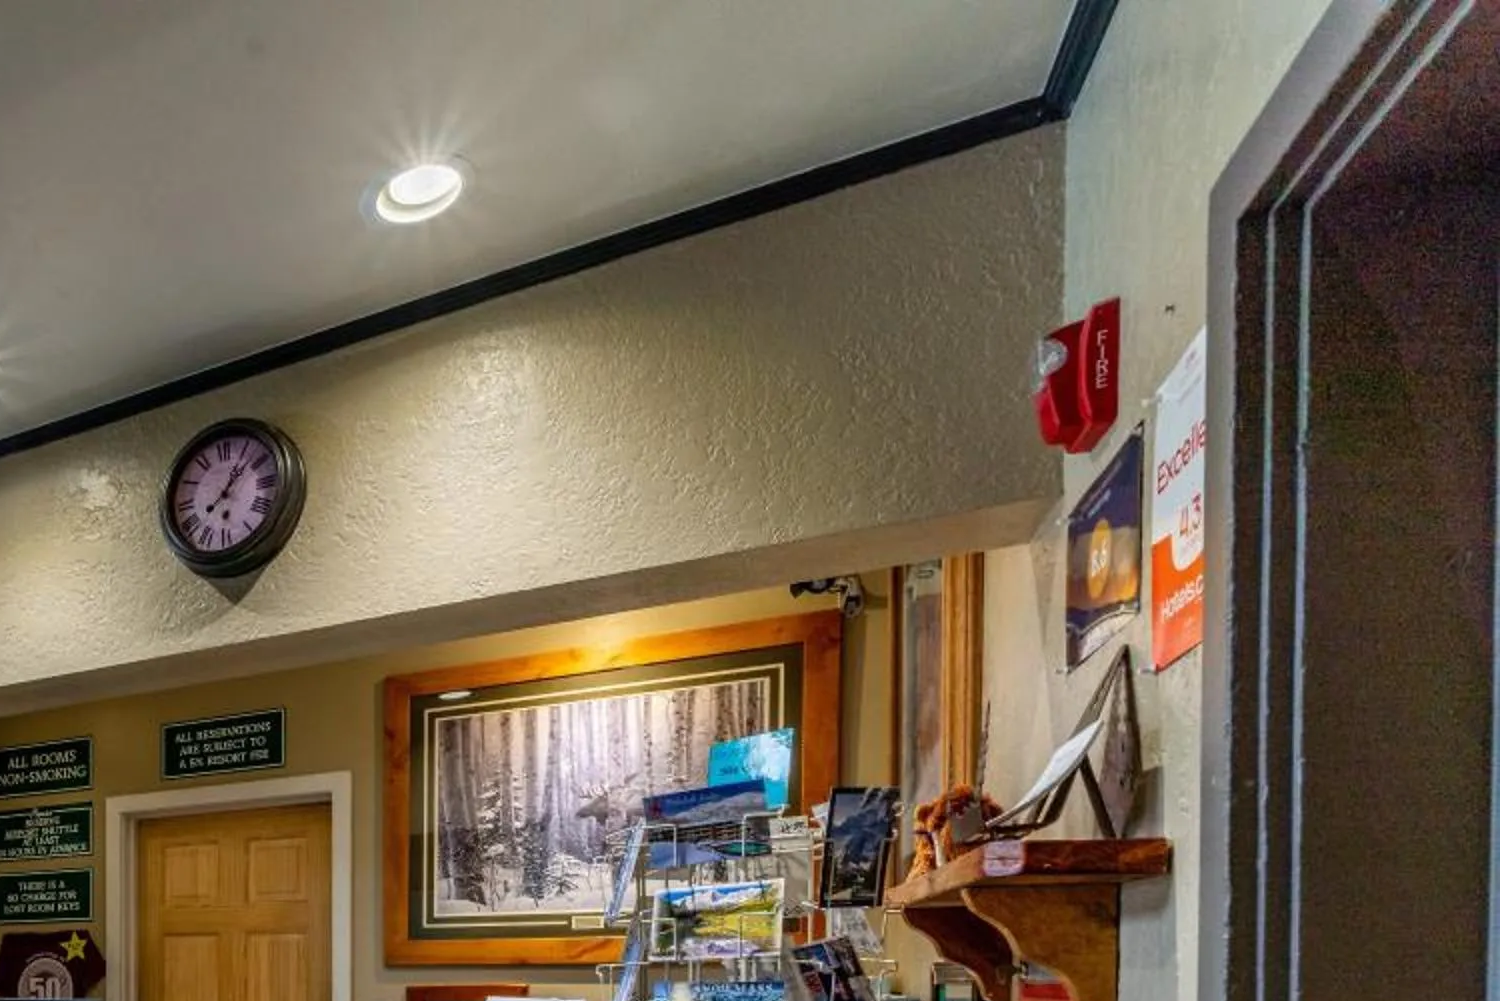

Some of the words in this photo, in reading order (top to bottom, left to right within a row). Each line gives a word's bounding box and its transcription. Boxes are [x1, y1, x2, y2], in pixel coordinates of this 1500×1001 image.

[1095, 329, 1109, 390] FIRE
[175, 731, 194, 743] ALL
[196, 721, 272, 741] RESERVATIONS
[179, 743, 201, 757] ARE
[203, 735, 247, 753] SUBJECT
[249, 735, 267, 747] TO
[7, 755, 28, 770] ALL
[31, 749, 77, 767] ROOMS
[179, 759, 188, 769] A
[207, 751, 248, 766] RESORT
[17, 880, 46, 892] THERE
[48, 880, 57, 890] IS
[59, 880, 67, 890] A
[20, 891, 57, 902] CHARGE
[58, 889, 78, 901] FOR
[3, 903, 27, 915] LOST
[27, 902, 55, 914] ROOM
[57, 900, 80, 912] KEYS
[29, 977, 61, 999] 50
